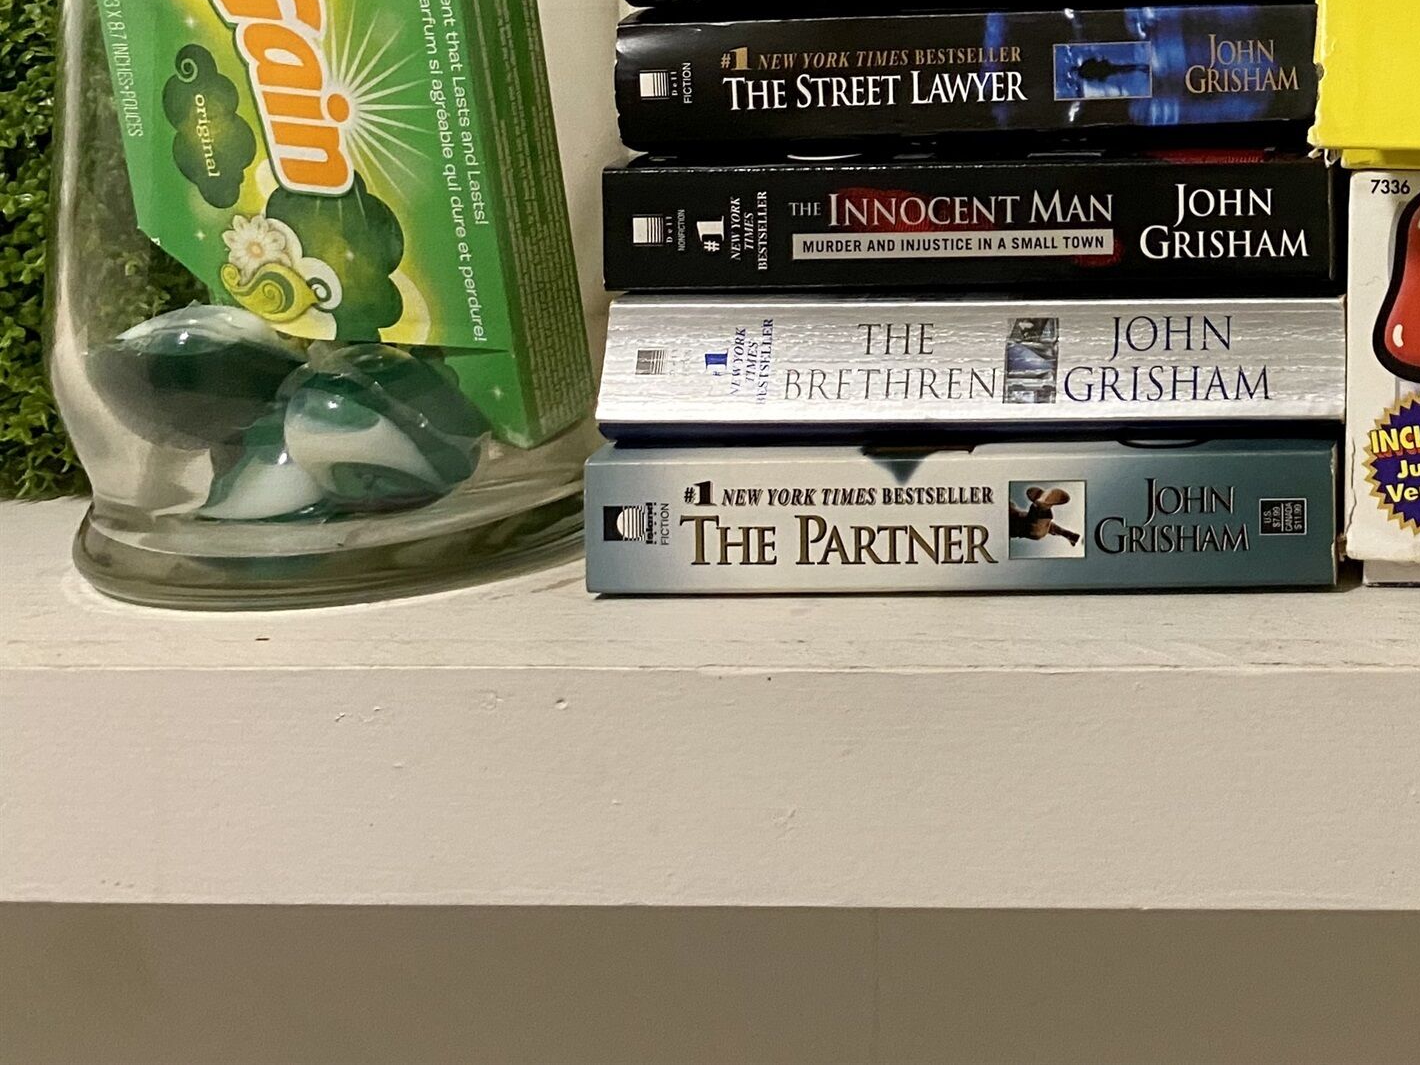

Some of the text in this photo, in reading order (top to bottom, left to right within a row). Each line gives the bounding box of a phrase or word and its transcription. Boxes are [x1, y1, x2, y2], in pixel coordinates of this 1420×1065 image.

[443, 29, 462, 72] that
[720, 46, 1022, 72] #1 NEW YORK TIMES BESTSELLER
[1209, 34, 1275, 68] JOHN
[683, 62, 693, 104] FICTION
[722, 70, 1028, 111] THE STREET LAWYER
[1184, 64, 1300, 94] GRISHAM
[430, 79, 454, 161] agréable
[452, 76, 471, 126] Lasts
[194, 93, 221, 178] original
[460, 127, 478, 167] and
[442, 164, 462, 192] qui
[1370, 179, 1411, 195] 7336
[450, 196, 467, 240] dure
[468, 171, 489, 226] Lasts!
[788, 189, 1115, 227] THE INNOCENT MAN
[1172, 182, 1274, 227] JOHN
[677, 209, 686, 252] NONFICTION
[696, 215, 725, 252] #1
[730, 196, 742, 261] NEW YORK
[744, 211, 755, 251] TIMES
[757, 191, 768, 271] BESTSELLER
[802, 234, 1104, 253] MURDER AND INJUSTICE IN A SMALL TOWN
[1139, 223, 1311, 260] GRISHAM
[457, 242, 471, 262] et
[458, 263, 487, 343] perdure!
[733, 326, 746, 365] YORK
[857, 322, 935, 356] THE
[1109, 315, 1233, 362] JOHN
[745, 341, 759, 384] TIMES
[784, 367, 999, 402] BRETHREN
[1063, 365, 1272, 403] GRISHAM
[683, 480, 994, 507] #1 NEW YORK TIMES BESTSELLER
[1144, 477, 1237, 527] JOHN
[660, 502, 670, 546] FICTION
[679, 514, 778, 566] THE
[794, 514, 999, 566] PARTNER
[1094, 515, 1250, 555] GRISHAM
